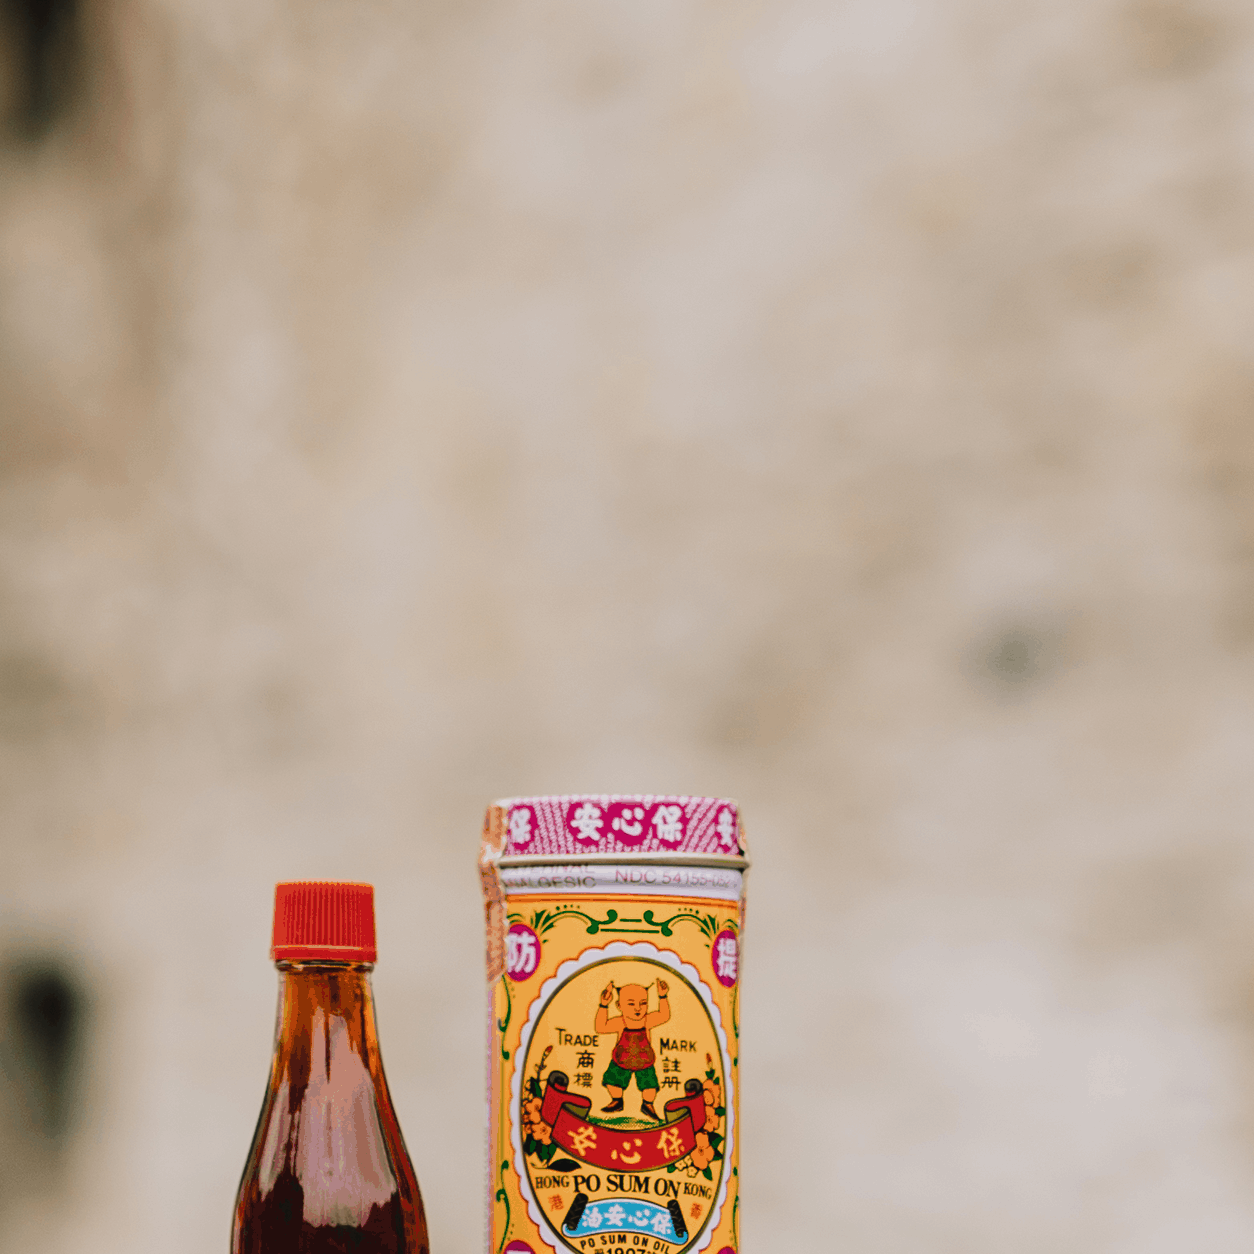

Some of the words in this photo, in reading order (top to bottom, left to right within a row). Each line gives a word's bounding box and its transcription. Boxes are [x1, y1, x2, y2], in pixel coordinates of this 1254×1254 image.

[615, 868, 657, 885] NDC
[555, 1027, 599, 1048] TRADE
[659, 1038, 698, 1056] MARK
[535, 1175, 570, 1190] HONG
[572, 1174, 601, 1193] PO
[606, 1174, 651, 1195] SUM
[654, 1177, 682, 1200] ON
[683, 1181, 713, 1201] KONG
[579, 1238, 596, 1251] PO
[601, 1234, 628, 1246] SUM
[632, 1235, 650, 1248] ON
